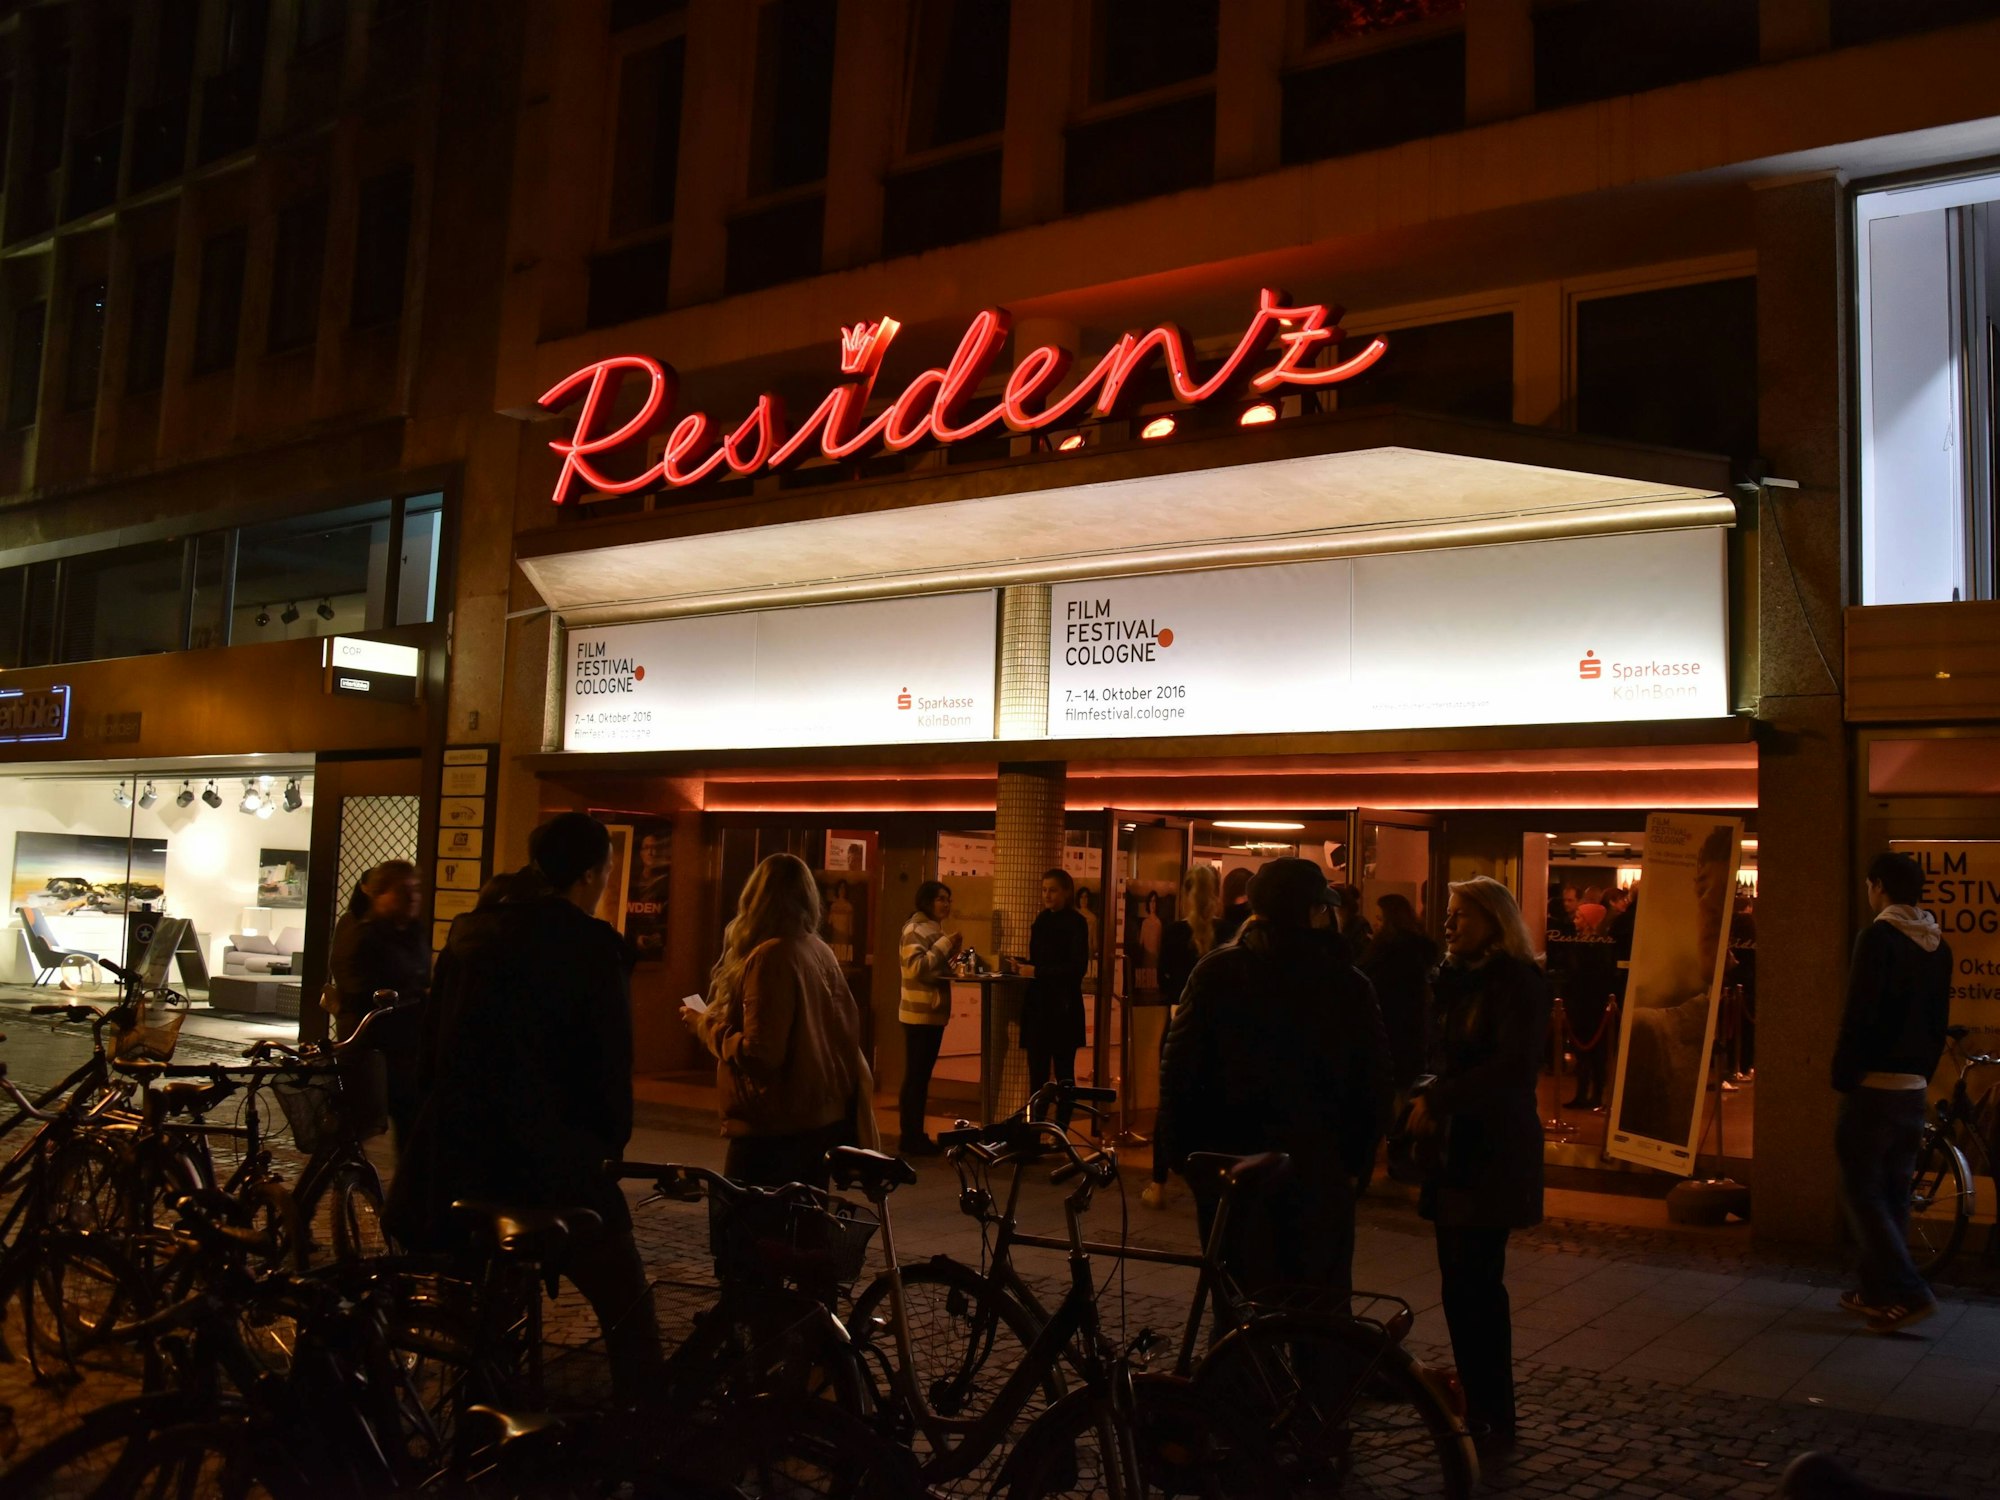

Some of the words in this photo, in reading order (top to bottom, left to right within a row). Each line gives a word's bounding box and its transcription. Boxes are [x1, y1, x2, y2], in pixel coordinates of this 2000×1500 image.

[538, 287, 1387, 505] Residenz
[1067, 598, 1111, 621] FILM
[1066, 618, 1159, 643] FESTIVAL
[577, 640, 606, 659] FILM
[1065, 642, 1156, 666] COLOGNE
[576, 657, 637, 677] FESTIVAL
[1612, 660, 1701, 682] Sparkasse
[575, 676, 634, 695] COLOGNE
[1102, 686, 1152, 701] Oktober
[1156, 685, 1186, 699] 2016
[1613, 684, 1698, 700] KölnBonn
[917, 696, 974, 712] Sparkasse
[1066, 706, 1185, 721] filmfestival.cologne
[598, 712, 631, 724] Oktober
[632, 711, 652, 723] 2016
[917, 714, 972, 728] KölnBonn
[1900, 851, 1967, 875] ILM
[1920, 880, 2000, 904] ESTIV
[1546, 929, 1616, 945] Residenz
